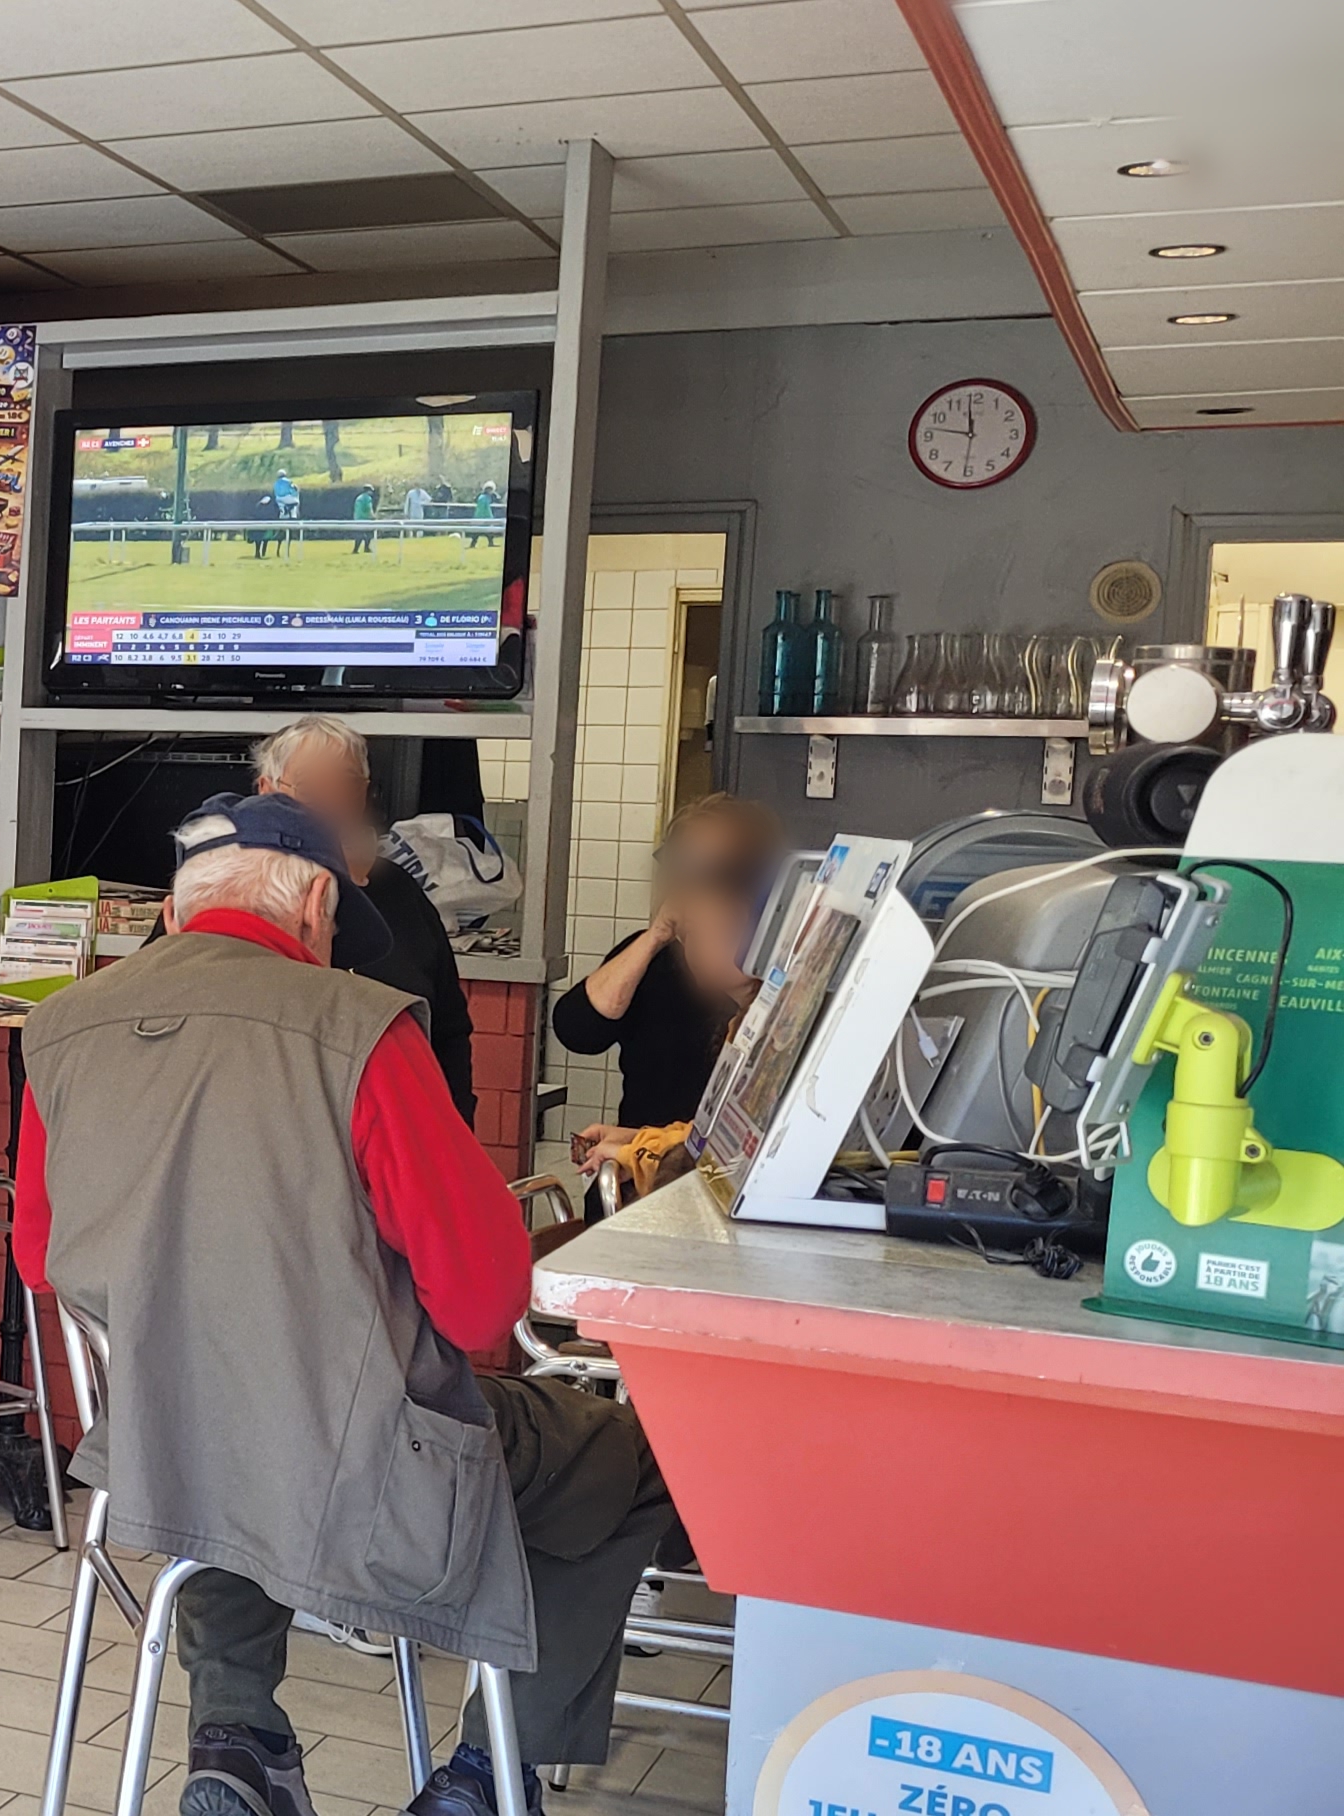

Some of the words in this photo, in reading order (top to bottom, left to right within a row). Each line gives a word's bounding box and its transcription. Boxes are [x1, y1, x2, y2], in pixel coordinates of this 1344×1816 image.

[967, 393, 984, 404] 12
[994, 398, 999, 409] 1
[946, 398, 961, 411] 11
[932, 412, 946, 424] 10
[1004, 410, 1015, 422] 2
[924, 431, 933, 442] 9
[1009, 429, 1019, 440] 3
[929, 449, 939, 460] 8
[1001, 447, 1011, 458] 4
[943, 461, 952, 472] 7
[985, 460, 995, 471] 5
[963, 466, 973, 477] 6
[73, 617, 90, 625] LES
[91, 616, 137, 625] PARTANTS
[282, 616, 288, 624] 2
[414, 616, 422, 624] 3
[1207, 947, 1288, 964] INCENNE
[956, 1188, 1000, 1202] EATON
[1129, 1255, 1173, 1284] RESPONSABLE
[1238, 1263, 1261, 1272] C'EST
[1214, 1268, 1247, 1279] PARTIR
[1248, 1272, 1260, 1280] DE
[1204, 1274, 1223, 1286] 18
[1228, 1278, 1260, 1292] ANS
[875, 1728, 942, 1764] -18
[951, 1744, 1044, 1786] ANS
[898, 1783, 1013, 1816] ZÉRO
